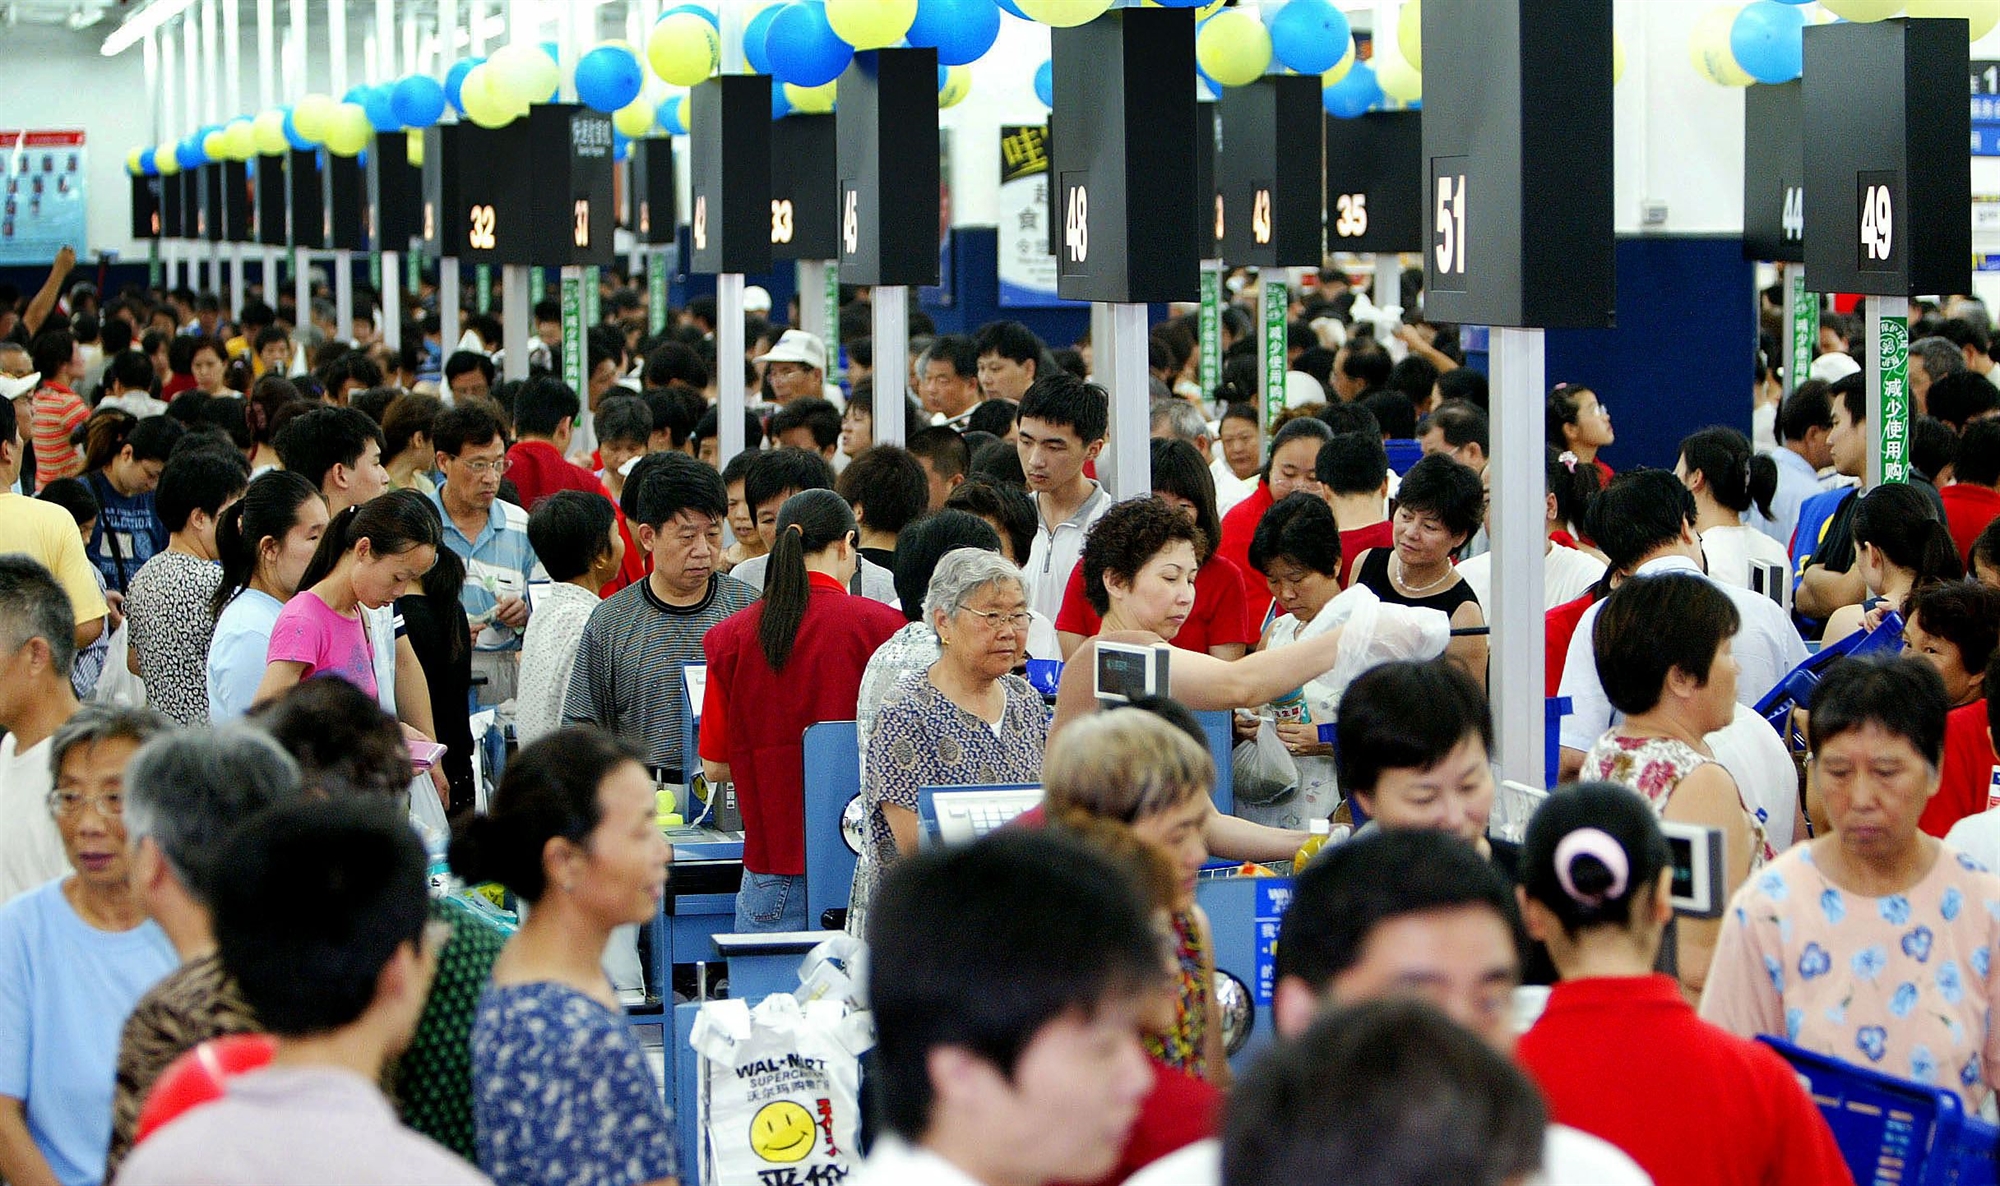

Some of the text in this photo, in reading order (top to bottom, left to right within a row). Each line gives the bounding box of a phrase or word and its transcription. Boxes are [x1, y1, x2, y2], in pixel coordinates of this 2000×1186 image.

[470, 204, 495, 248] 32
[770, 199, 793, 243] 33
[844, 190, 857, 254] 45
[1066, 185, 1087, 262] 48
[1253, 190, 1271, 243] 43
[1336, 193, 1367, 236] 35
[1436, 175, 1465, 273] 51
[1783, 187, 1803, 240] 44
[1861, 185, 1892, 260] 49
[1885, 378, 1902, 480] 减少使用购
